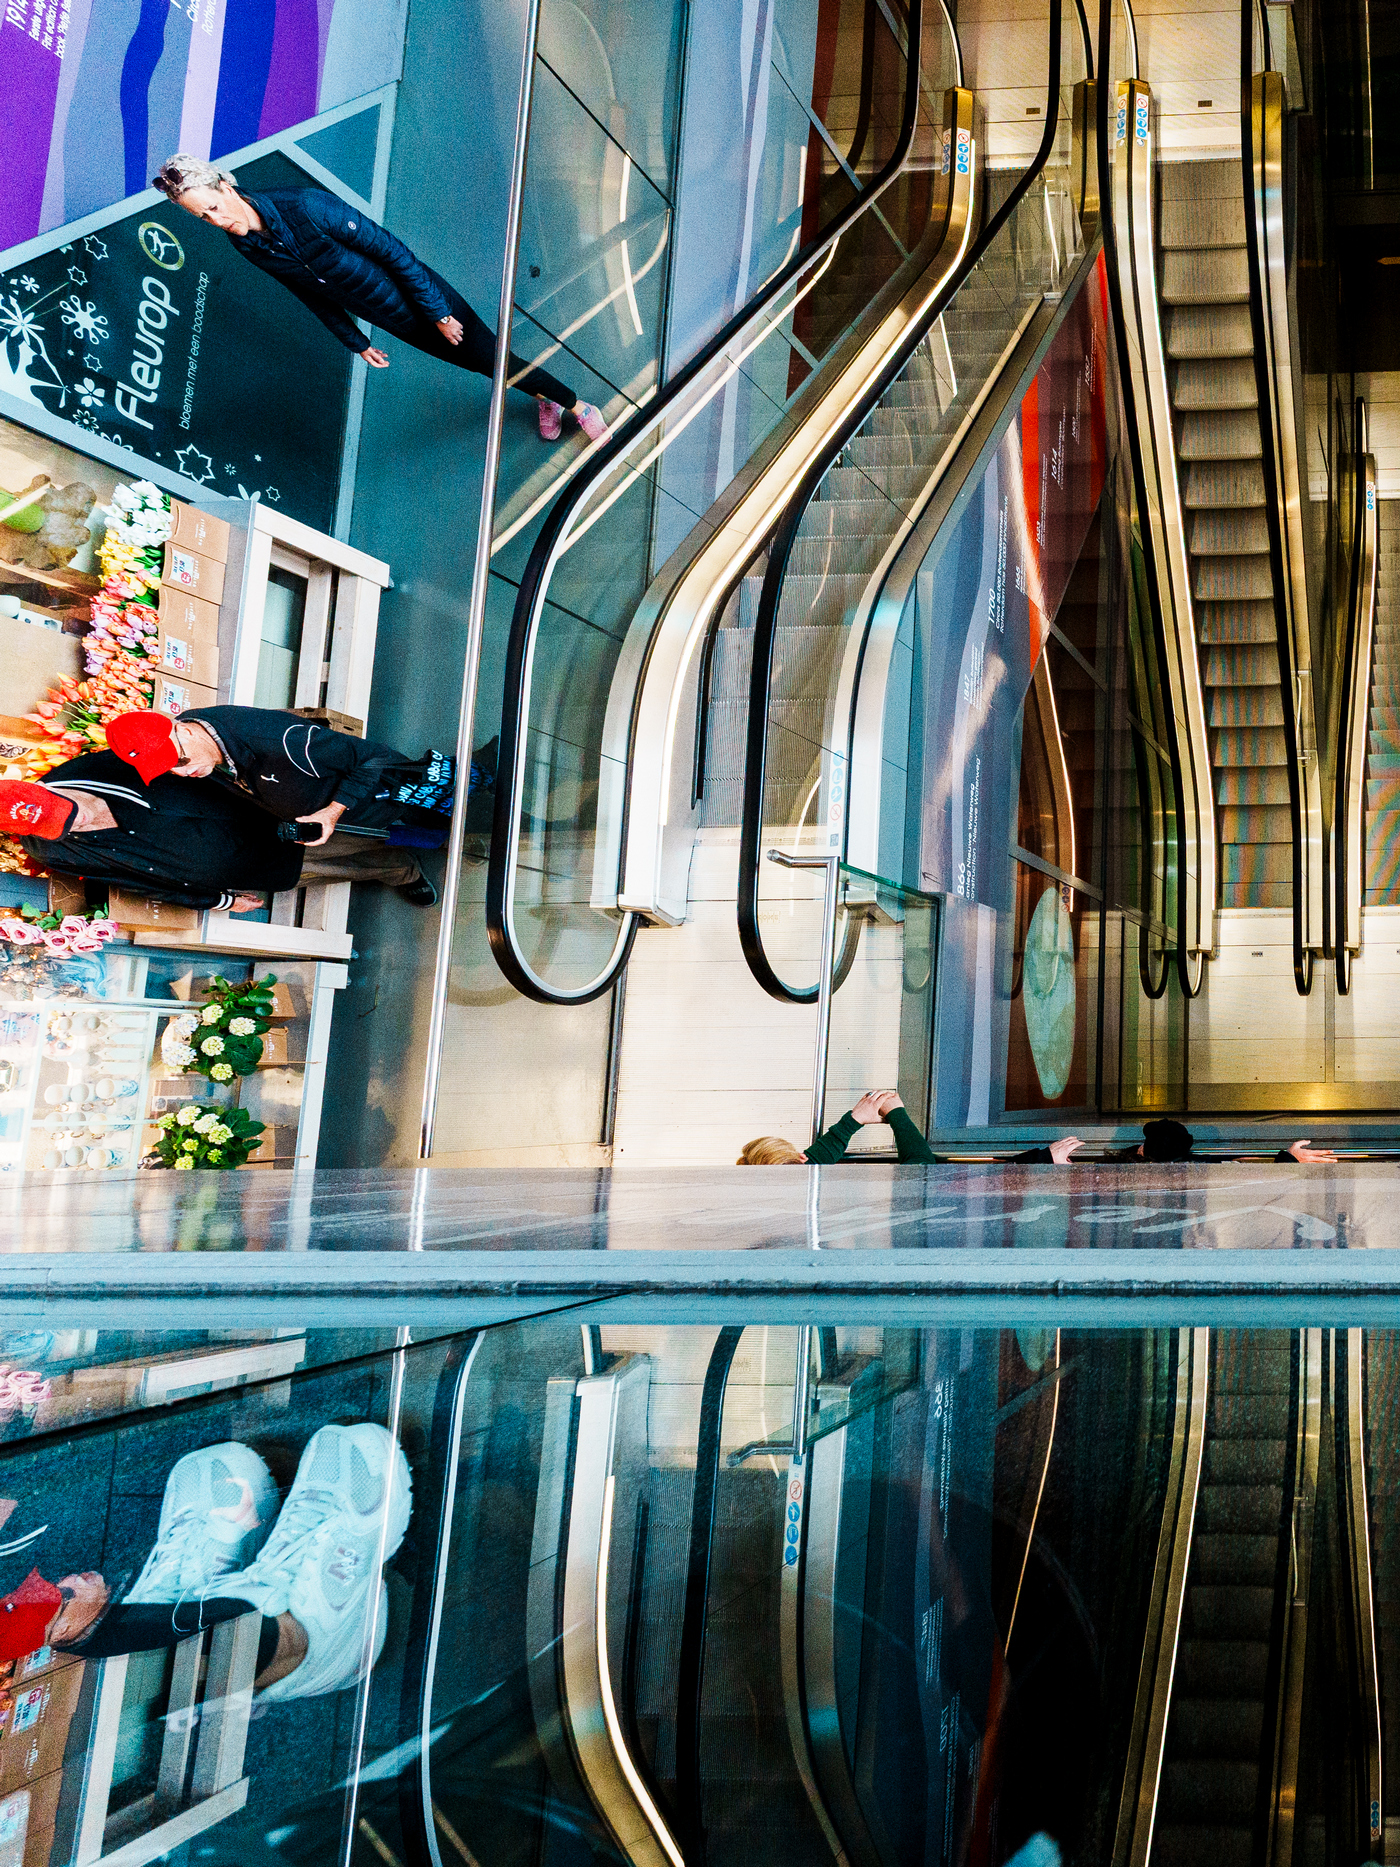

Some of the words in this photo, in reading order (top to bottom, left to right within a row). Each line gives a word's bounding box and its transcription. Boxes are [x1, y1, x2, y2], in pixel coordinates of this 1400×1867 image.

[190, 270, 212, 333] boodschap
[115, 276, 180, 430] Fleurop
[190, 333, 200, 357] een
[186, 355, 197, 380] met
[178, 381, 195, 430] bloemen
[987, 587, 996, 625] 1700
